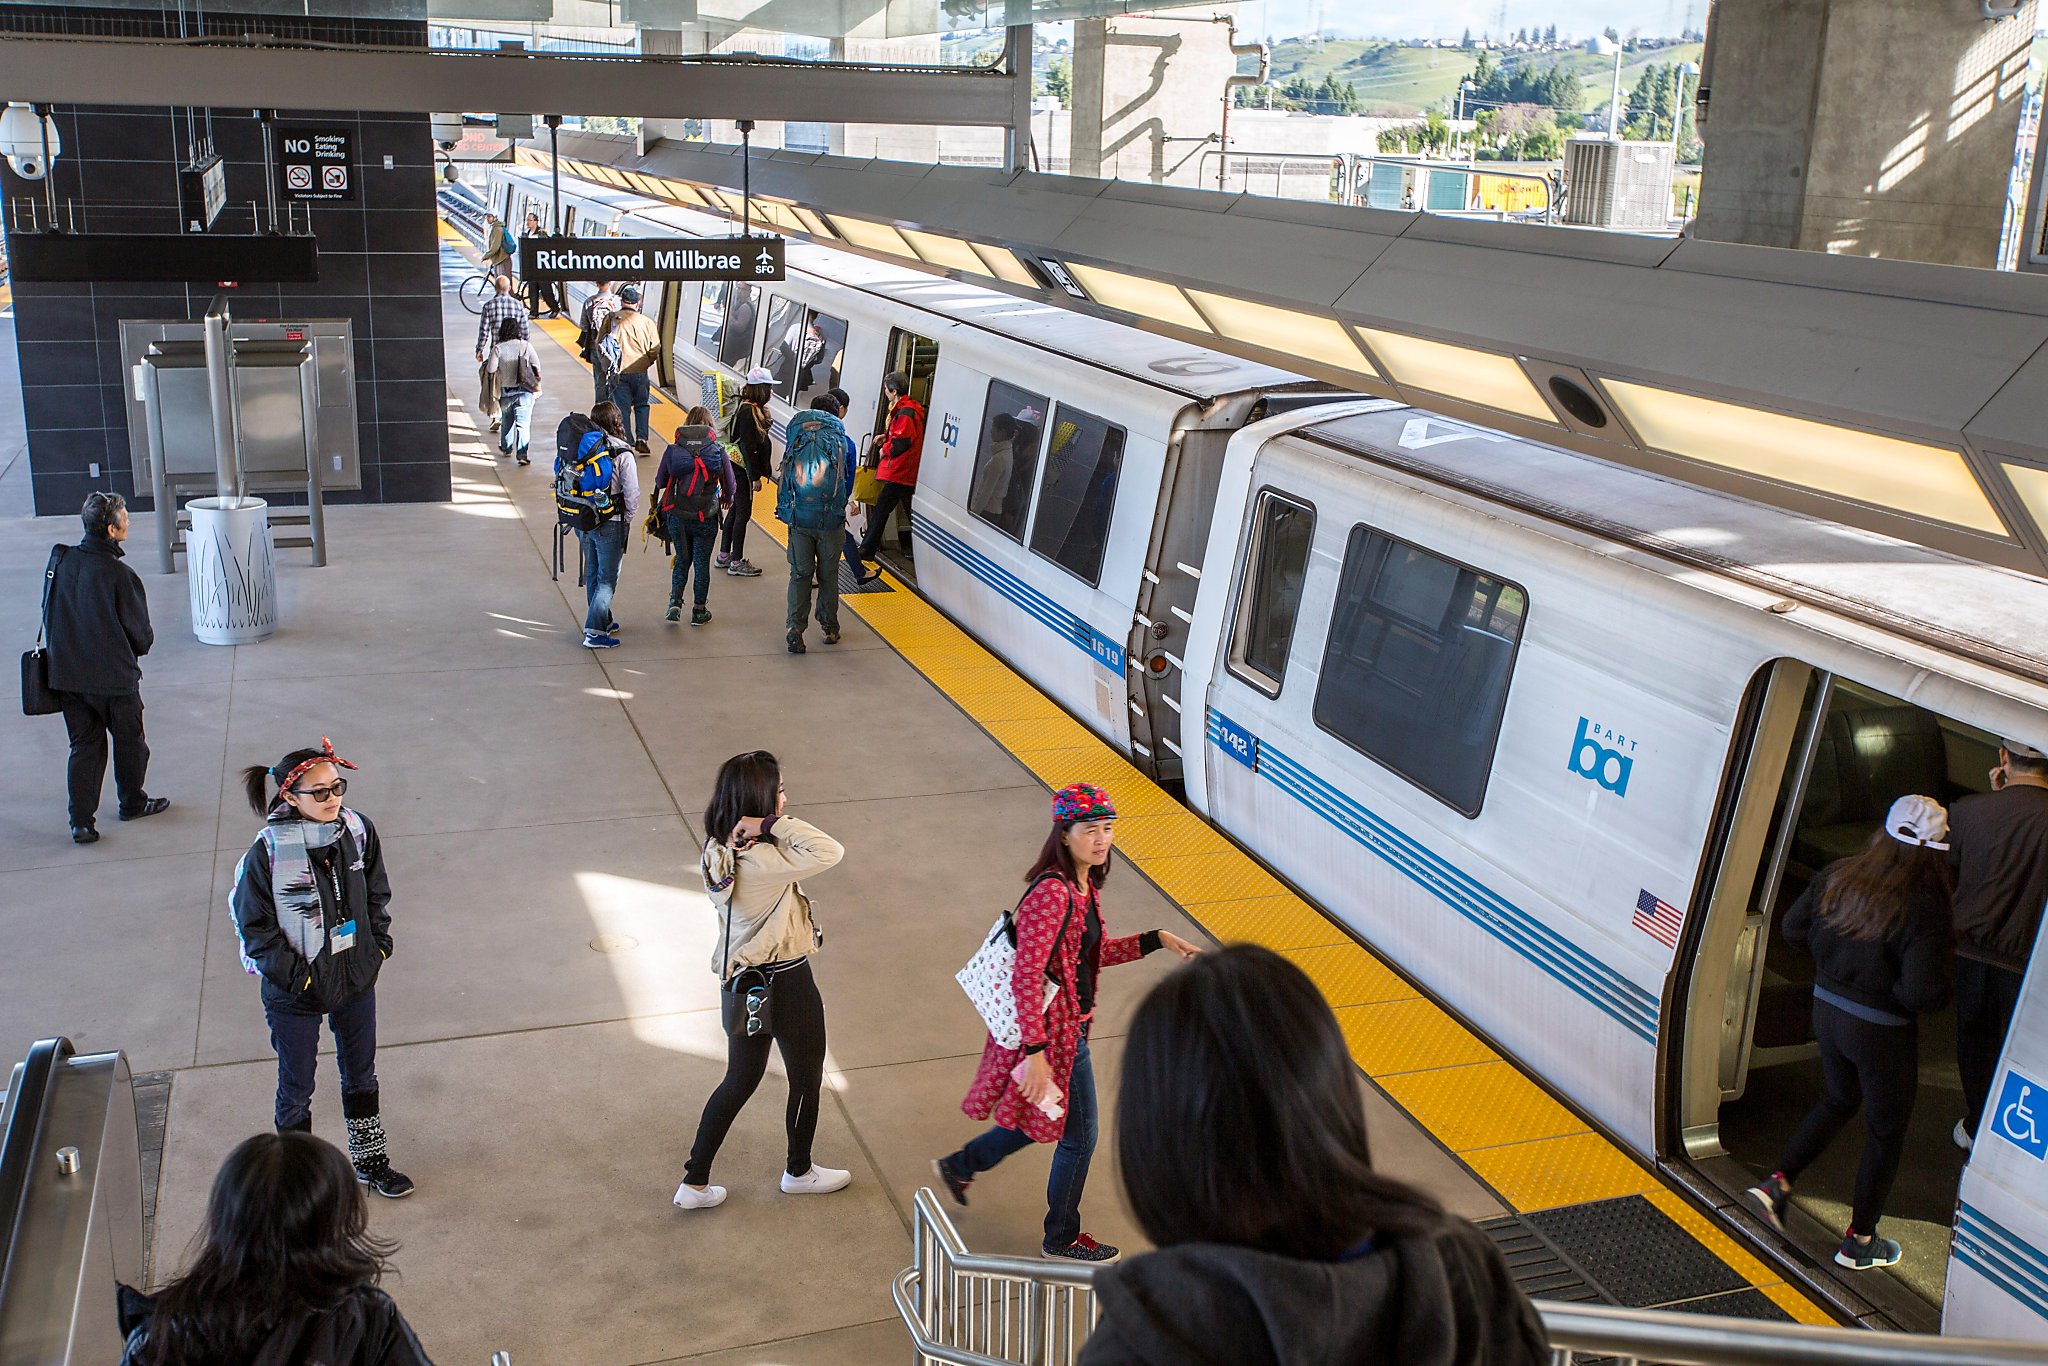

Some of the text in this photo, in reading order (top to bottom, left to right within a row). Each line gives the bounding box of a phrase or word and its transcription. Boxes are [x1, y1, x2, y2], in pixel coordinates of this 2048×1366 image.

[314, 135, 345, 144] Smoking
[285, 139, 310, 153] NO
[315, 143, 338, 151] Eating
[315, 150, 346, 159] Drinking
[537, 250, 741, 270] Richmond Millbrae
[755, 265, 775, 274] SFO
[1091, 637, 1119, 667] 1619
[1593, 723, 1638, 751] BART
